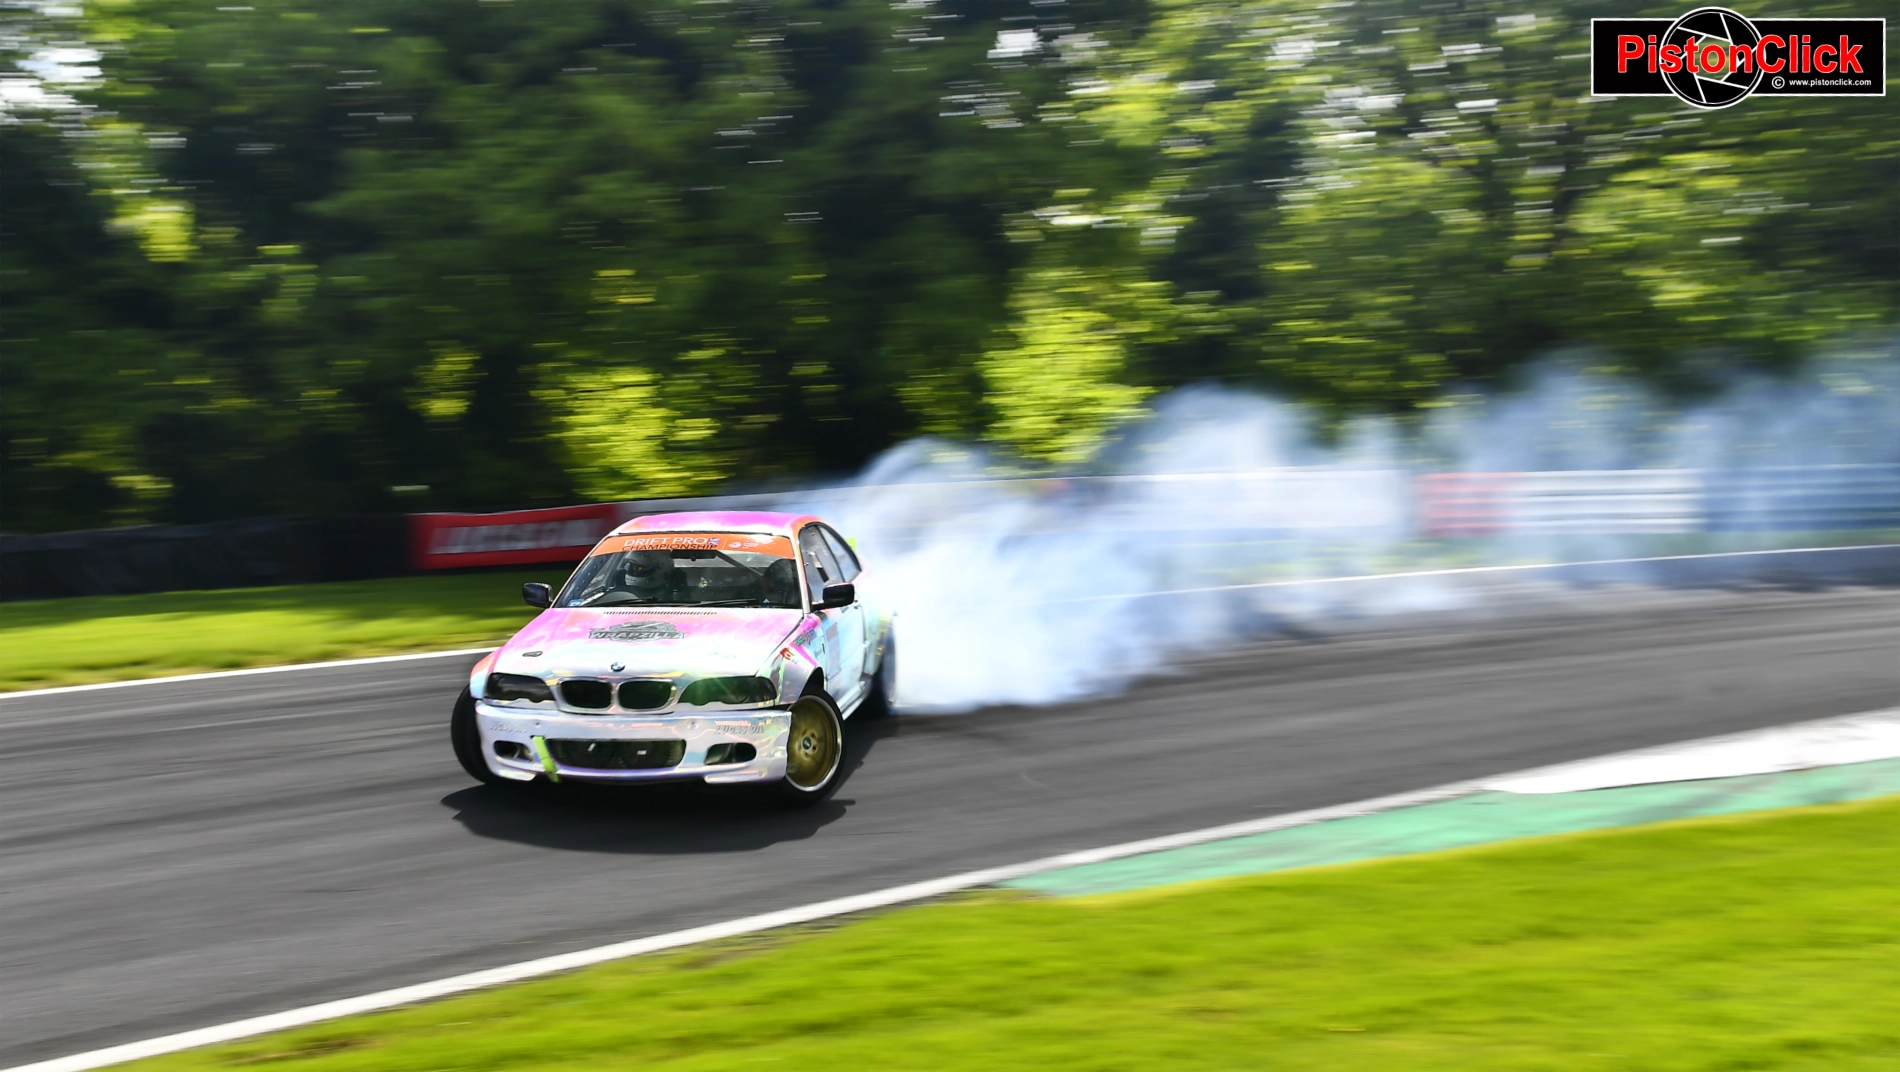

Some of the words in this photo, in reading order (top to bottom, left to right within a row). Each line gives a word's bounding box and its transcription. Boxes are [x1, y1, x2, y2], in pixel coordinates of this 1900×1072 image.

[624, 537, 671, 546] DRIFT
[672, 537, 708, 545] PRO
[622, 543, 718, 551] CHAMPIONSHIP
[589, 631, 685, 639] WRAPZILLA
